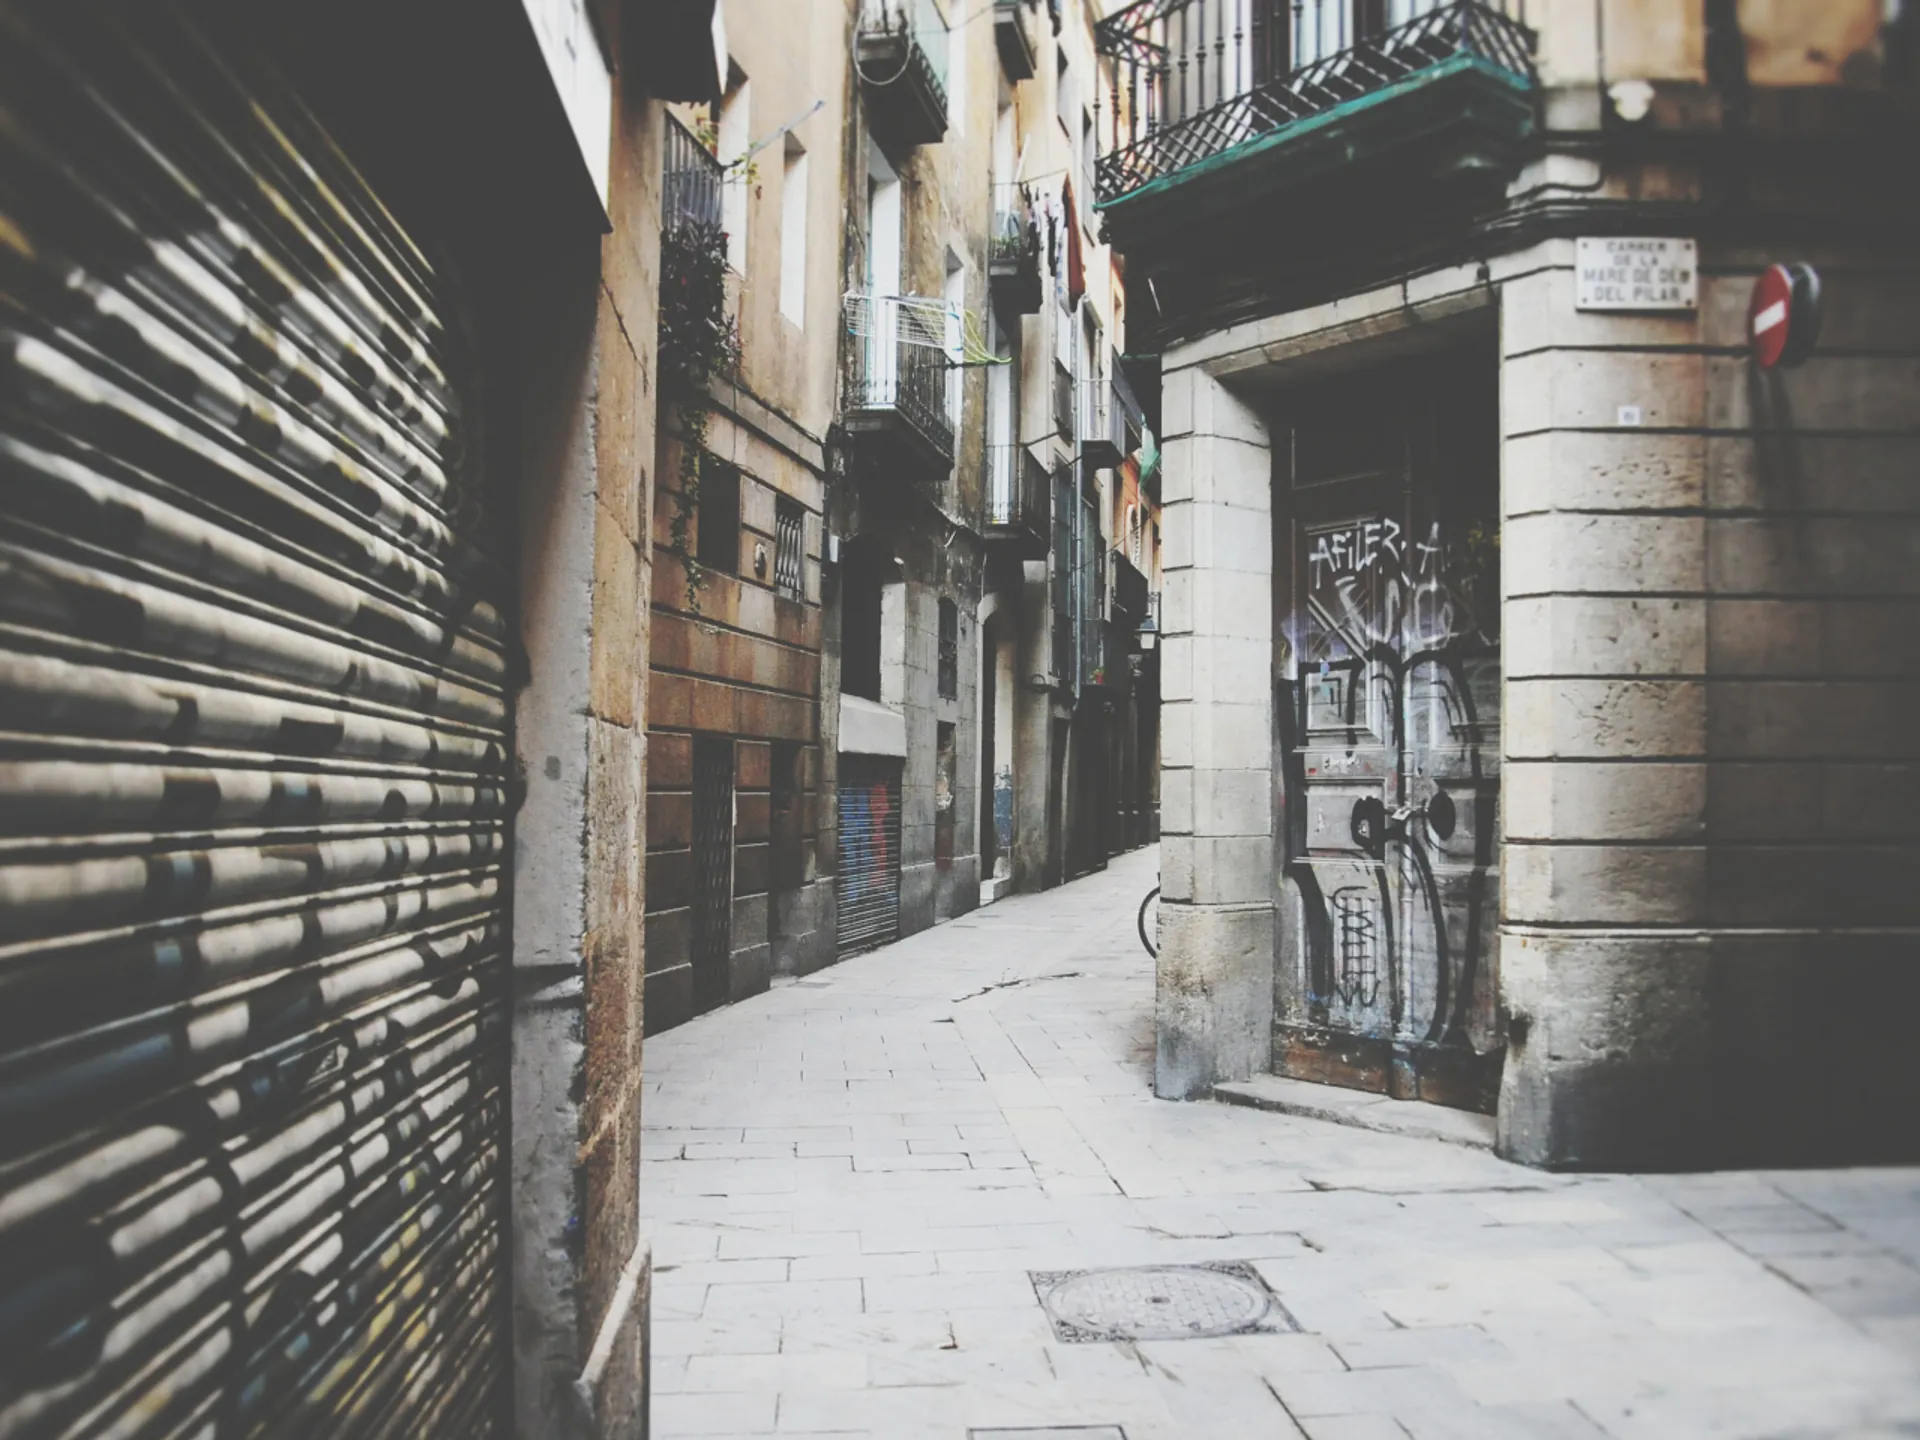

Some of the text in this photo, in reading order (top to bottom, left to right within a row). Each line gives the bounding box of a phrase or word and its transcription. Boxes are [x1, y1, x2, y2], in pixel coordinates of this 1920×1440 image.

[1606, 241, 1667, 253] CARRER
[1613, 254, 1659, 267] DE LA
[1583, 268, 1626, 283] MARE
[1633, 268, 1652, 283] DE
[1594, 286, 1680, 302] DEL PILAR
